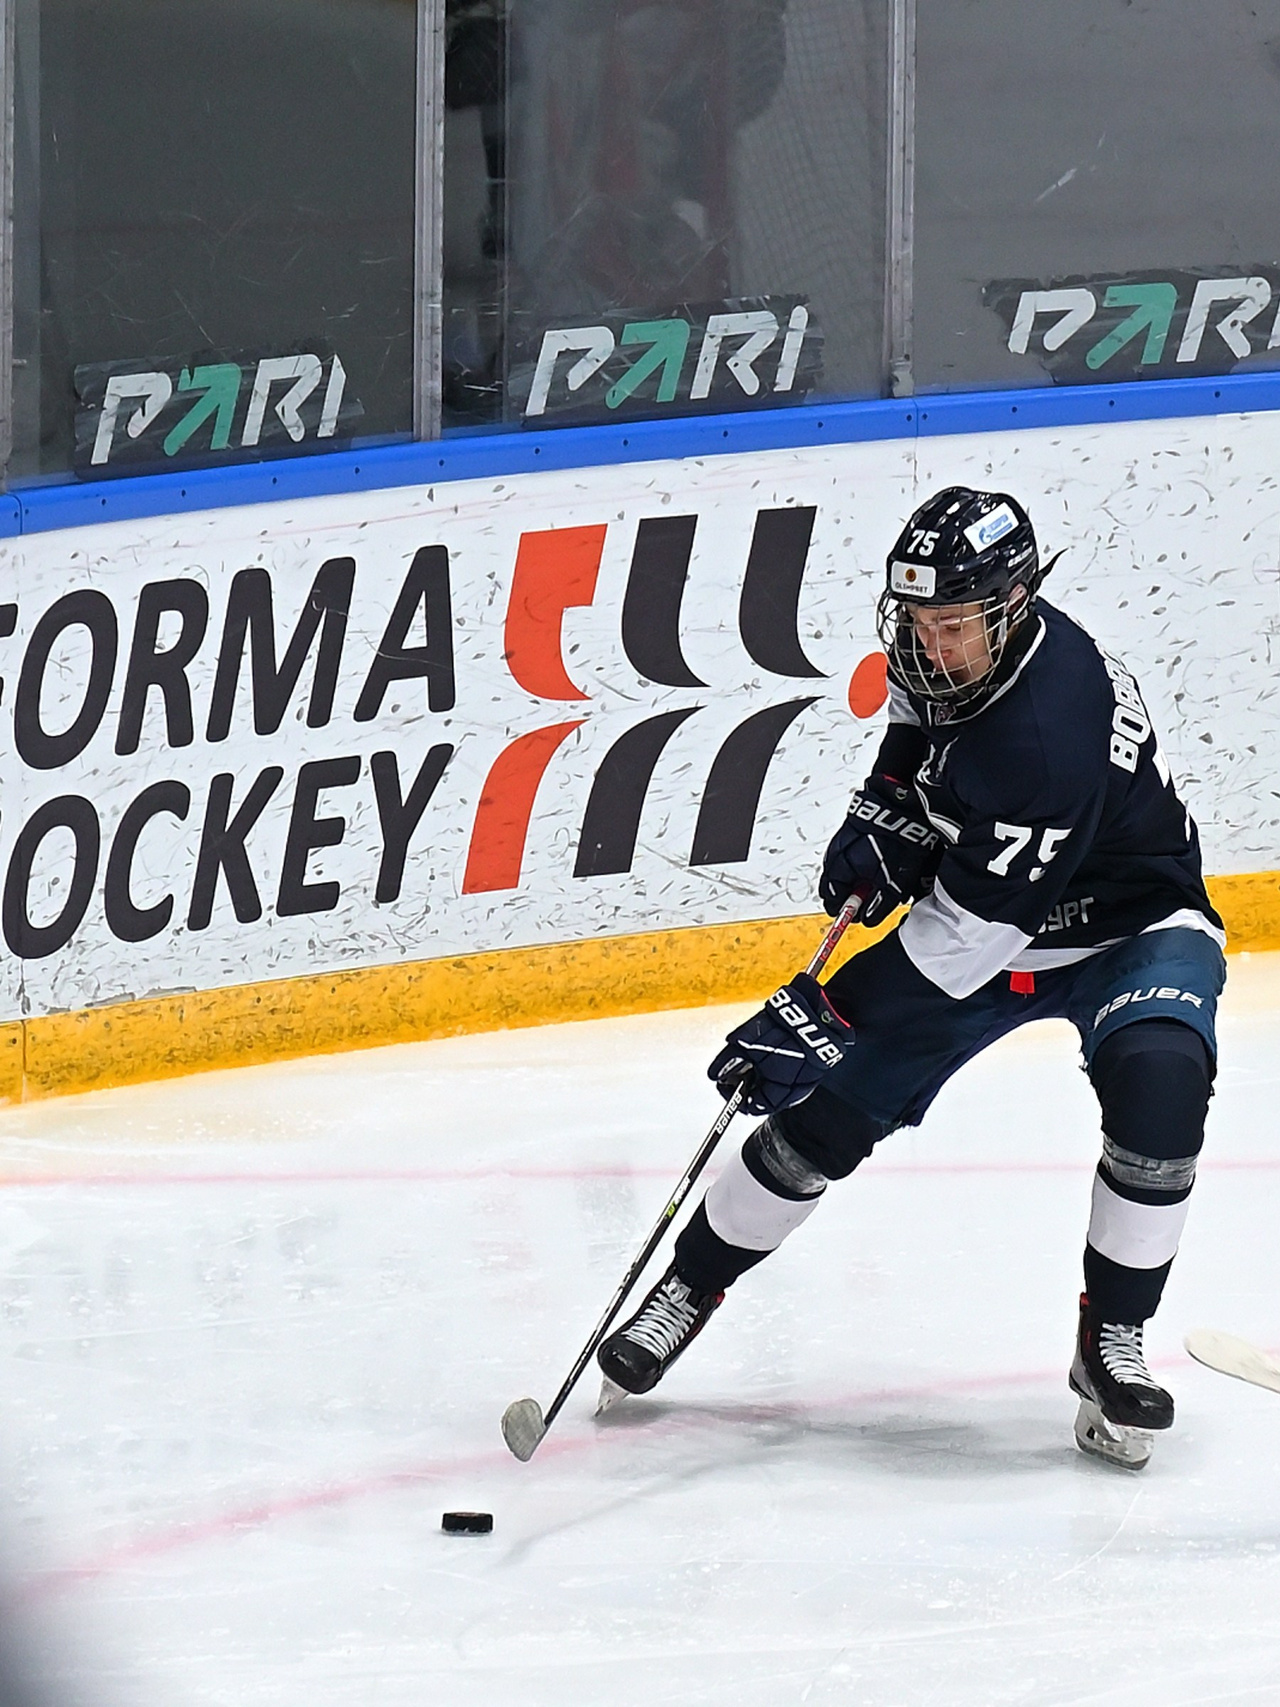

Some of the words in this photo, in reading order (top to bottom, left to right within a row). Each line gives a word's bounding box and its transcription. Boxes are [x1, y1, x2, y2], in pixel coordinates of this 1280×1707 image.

[525, 305, 809, 417] PARI
[91, 353, 346, 467] PARI
[906, 529, 941, 557] 75
[0, 545, 456, 770] ORMA
[0, 743, 455, 960] OCKEY
[848, 794, 940, 851] BAUER
[986, 821, 1074, 883] 75
[1037, 896, 1095, 934] УРГ
[768, 987, 844, 1069] BAUER
[1093, 987, 1205, 1031] BAUER
